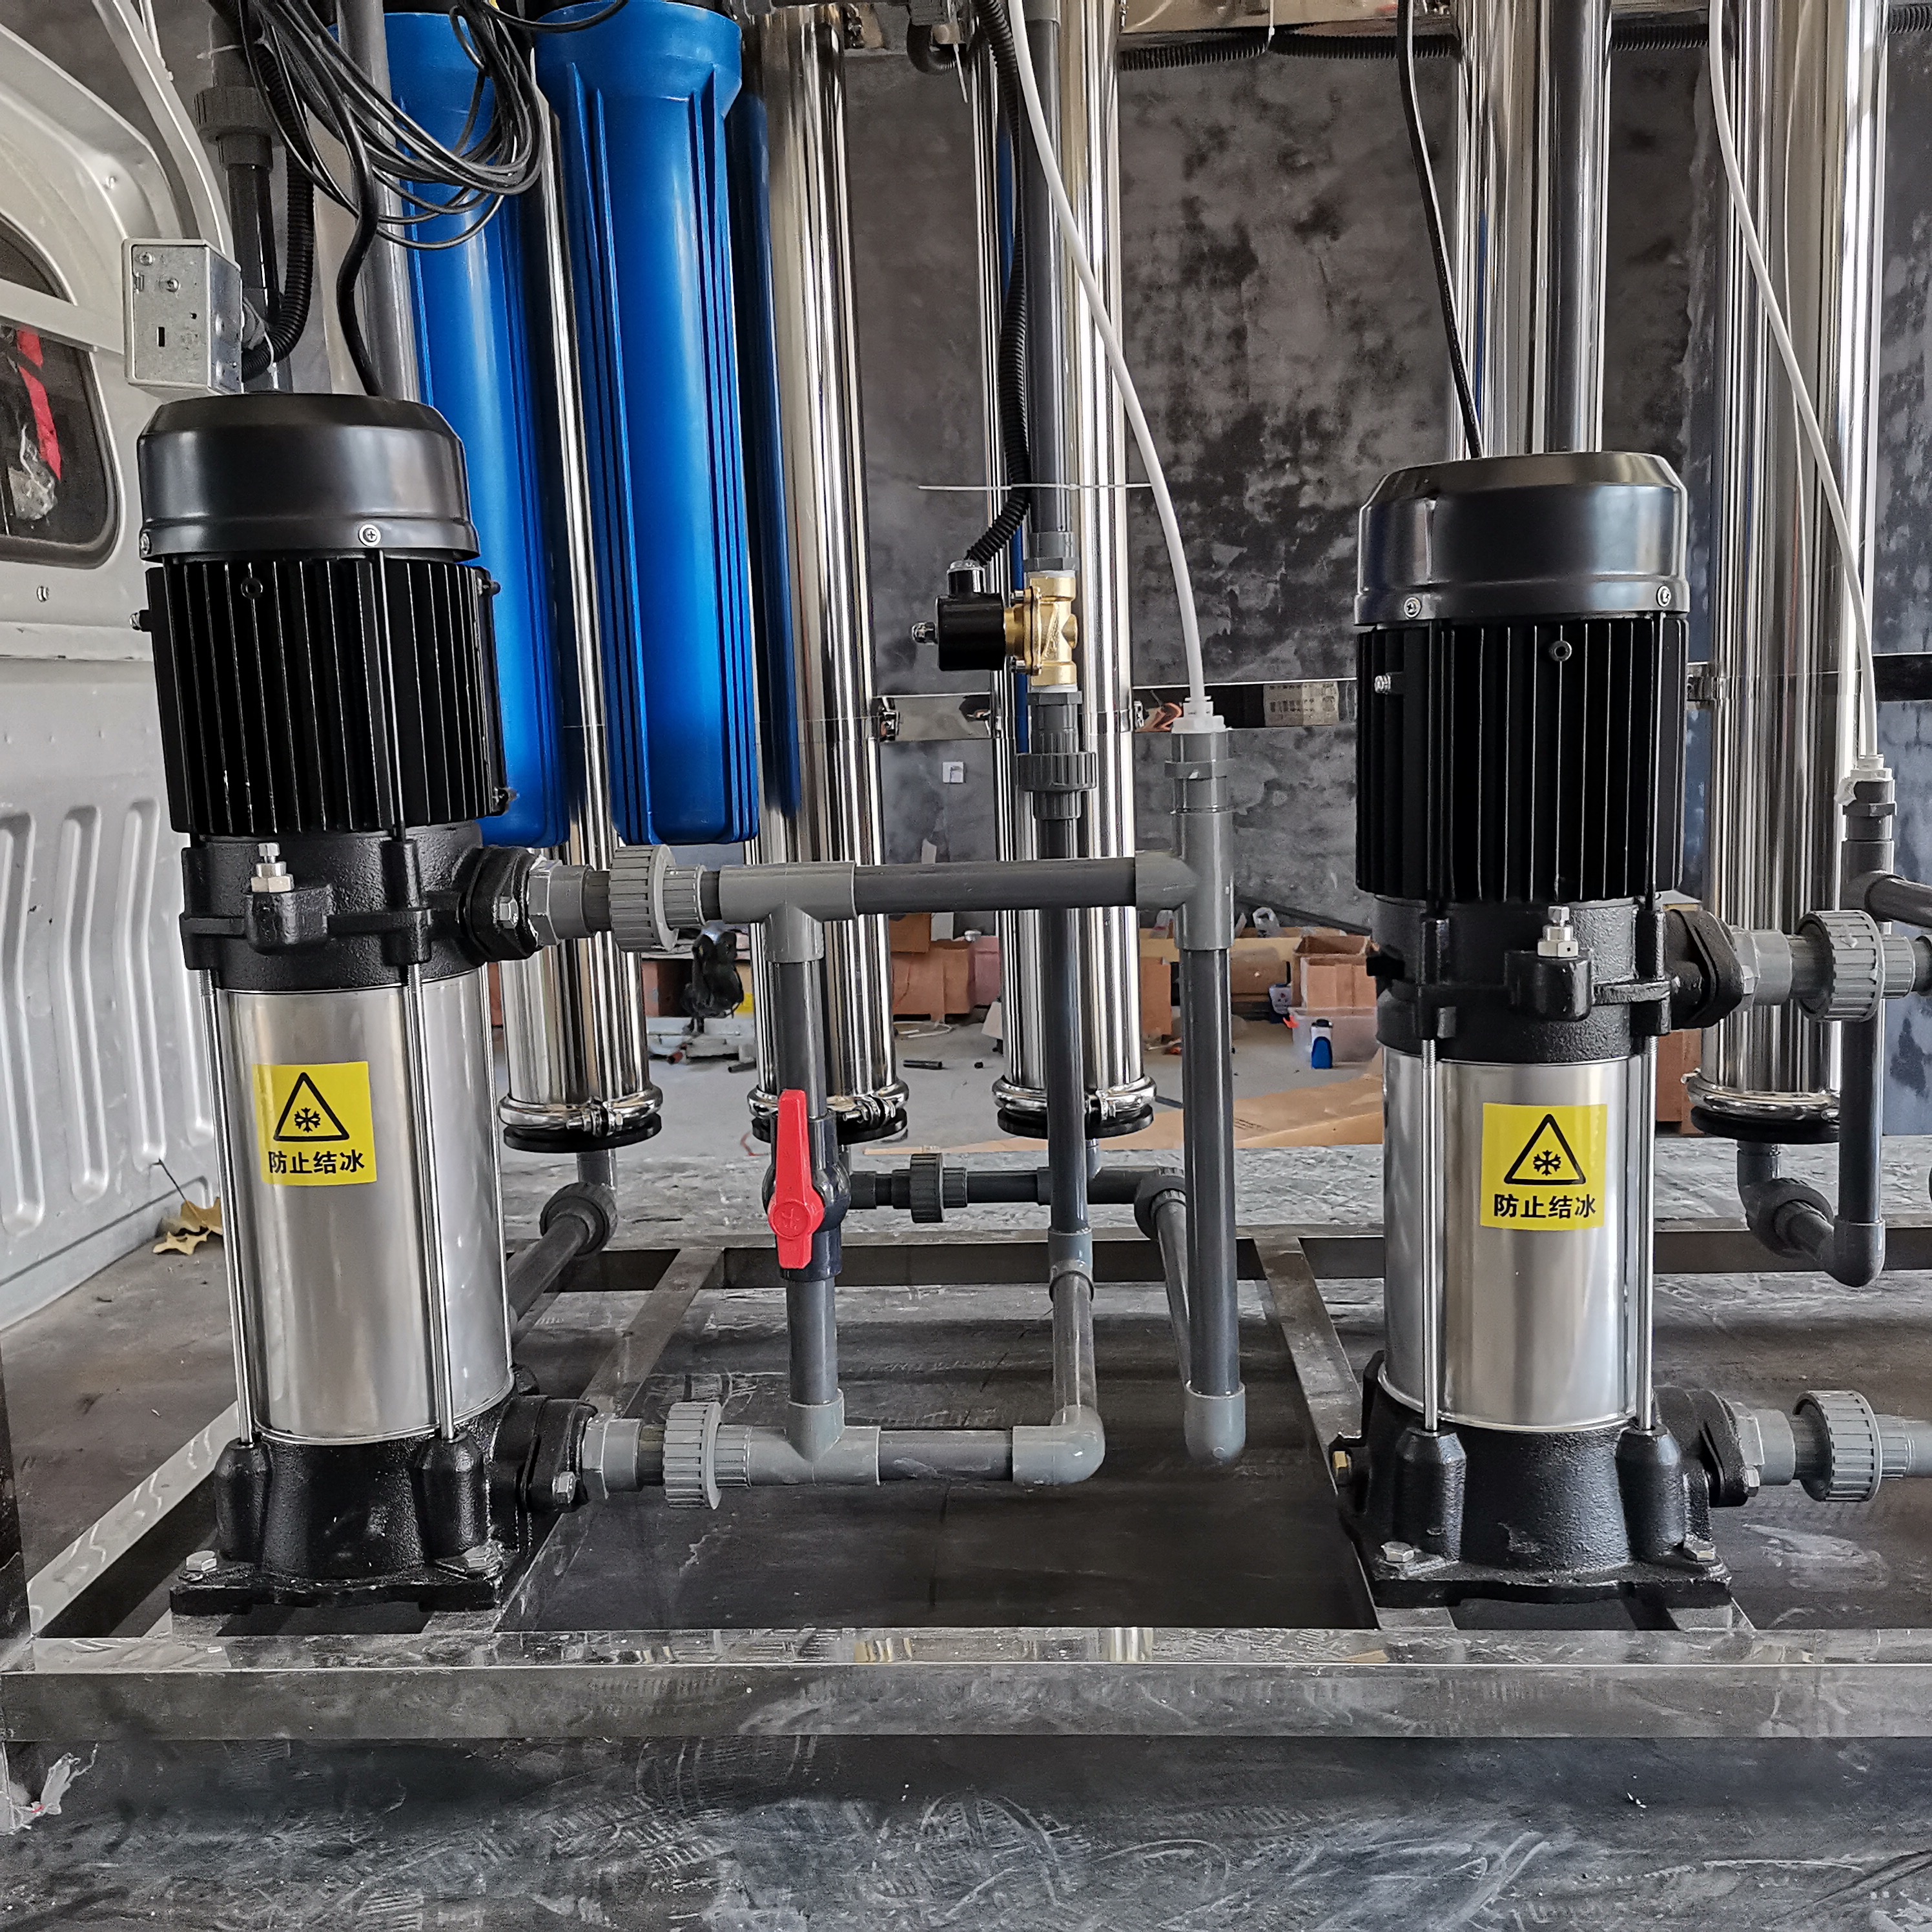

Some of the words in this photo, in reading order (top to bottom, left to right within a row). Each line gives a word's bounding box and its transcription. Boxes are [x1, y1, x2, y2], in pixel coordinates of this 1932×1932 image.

[268, 1149, 365, 1174] 防止结冰
[1494, 1194, 1596, 1219] 防止结冰
